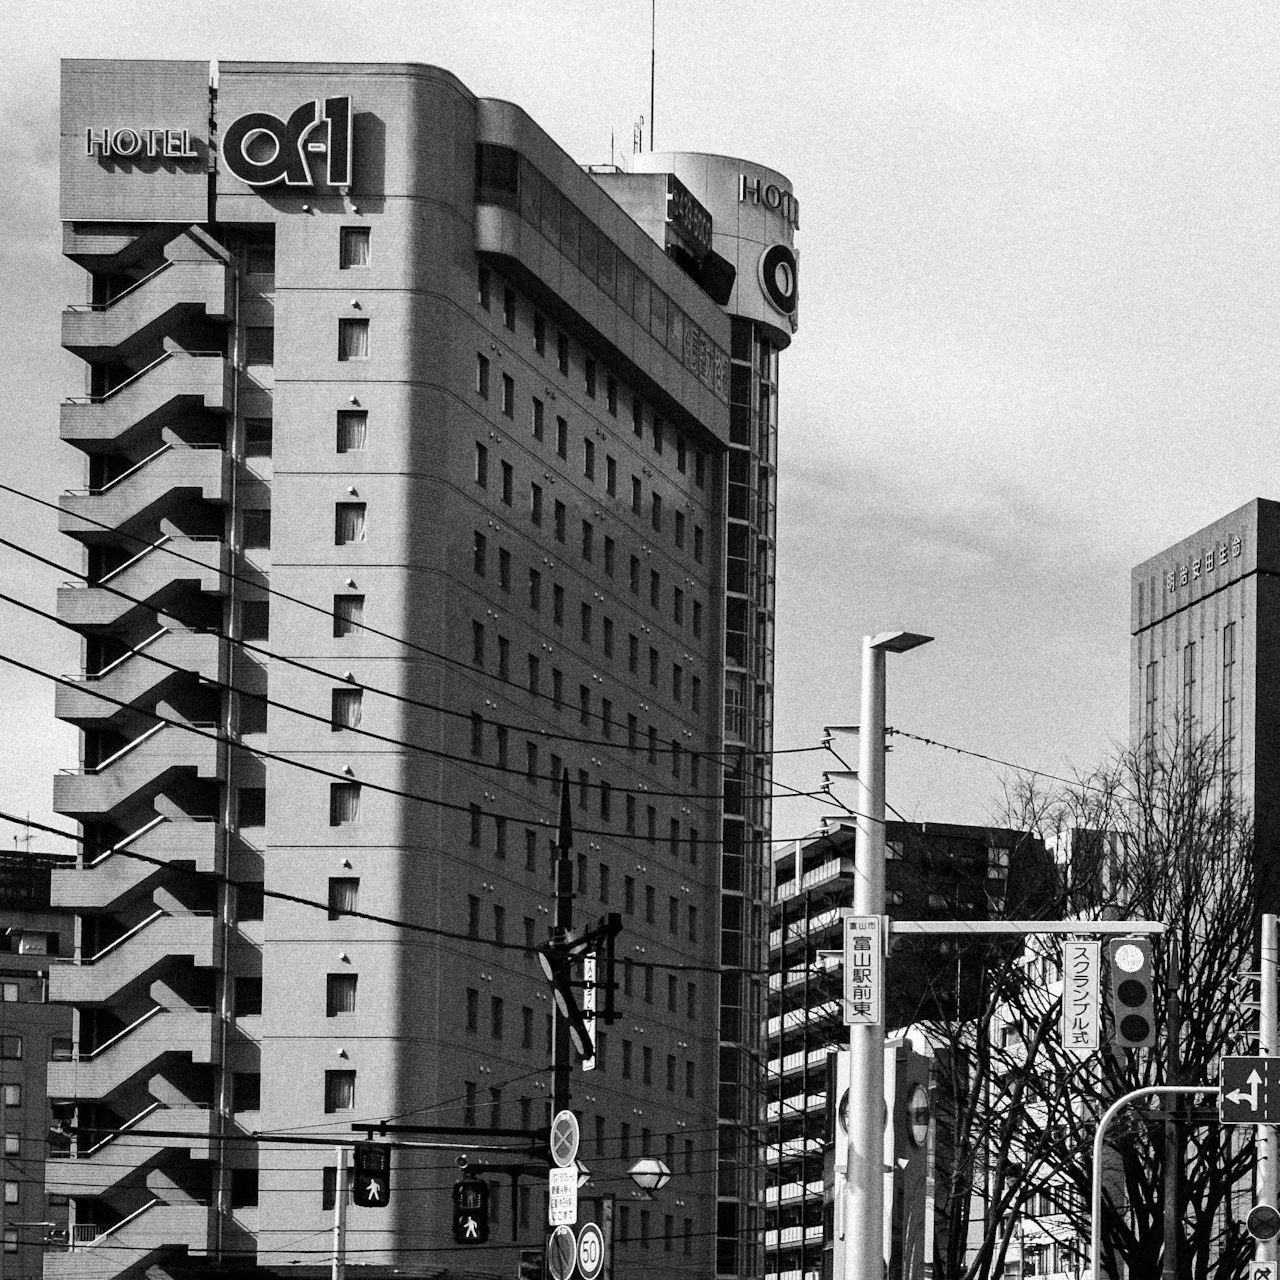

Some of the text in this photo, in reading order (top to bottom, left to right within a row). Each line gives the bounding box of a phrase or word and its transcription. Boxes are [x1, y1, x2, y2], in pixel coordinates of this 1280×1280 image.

[86, 127, 198, 157] HOTEL
[852, 935, 872, 1017] 富山駅前東
[1072, 947, 1090, 1045] スクランブル式
[582, 1240, 597, 1264] 50
